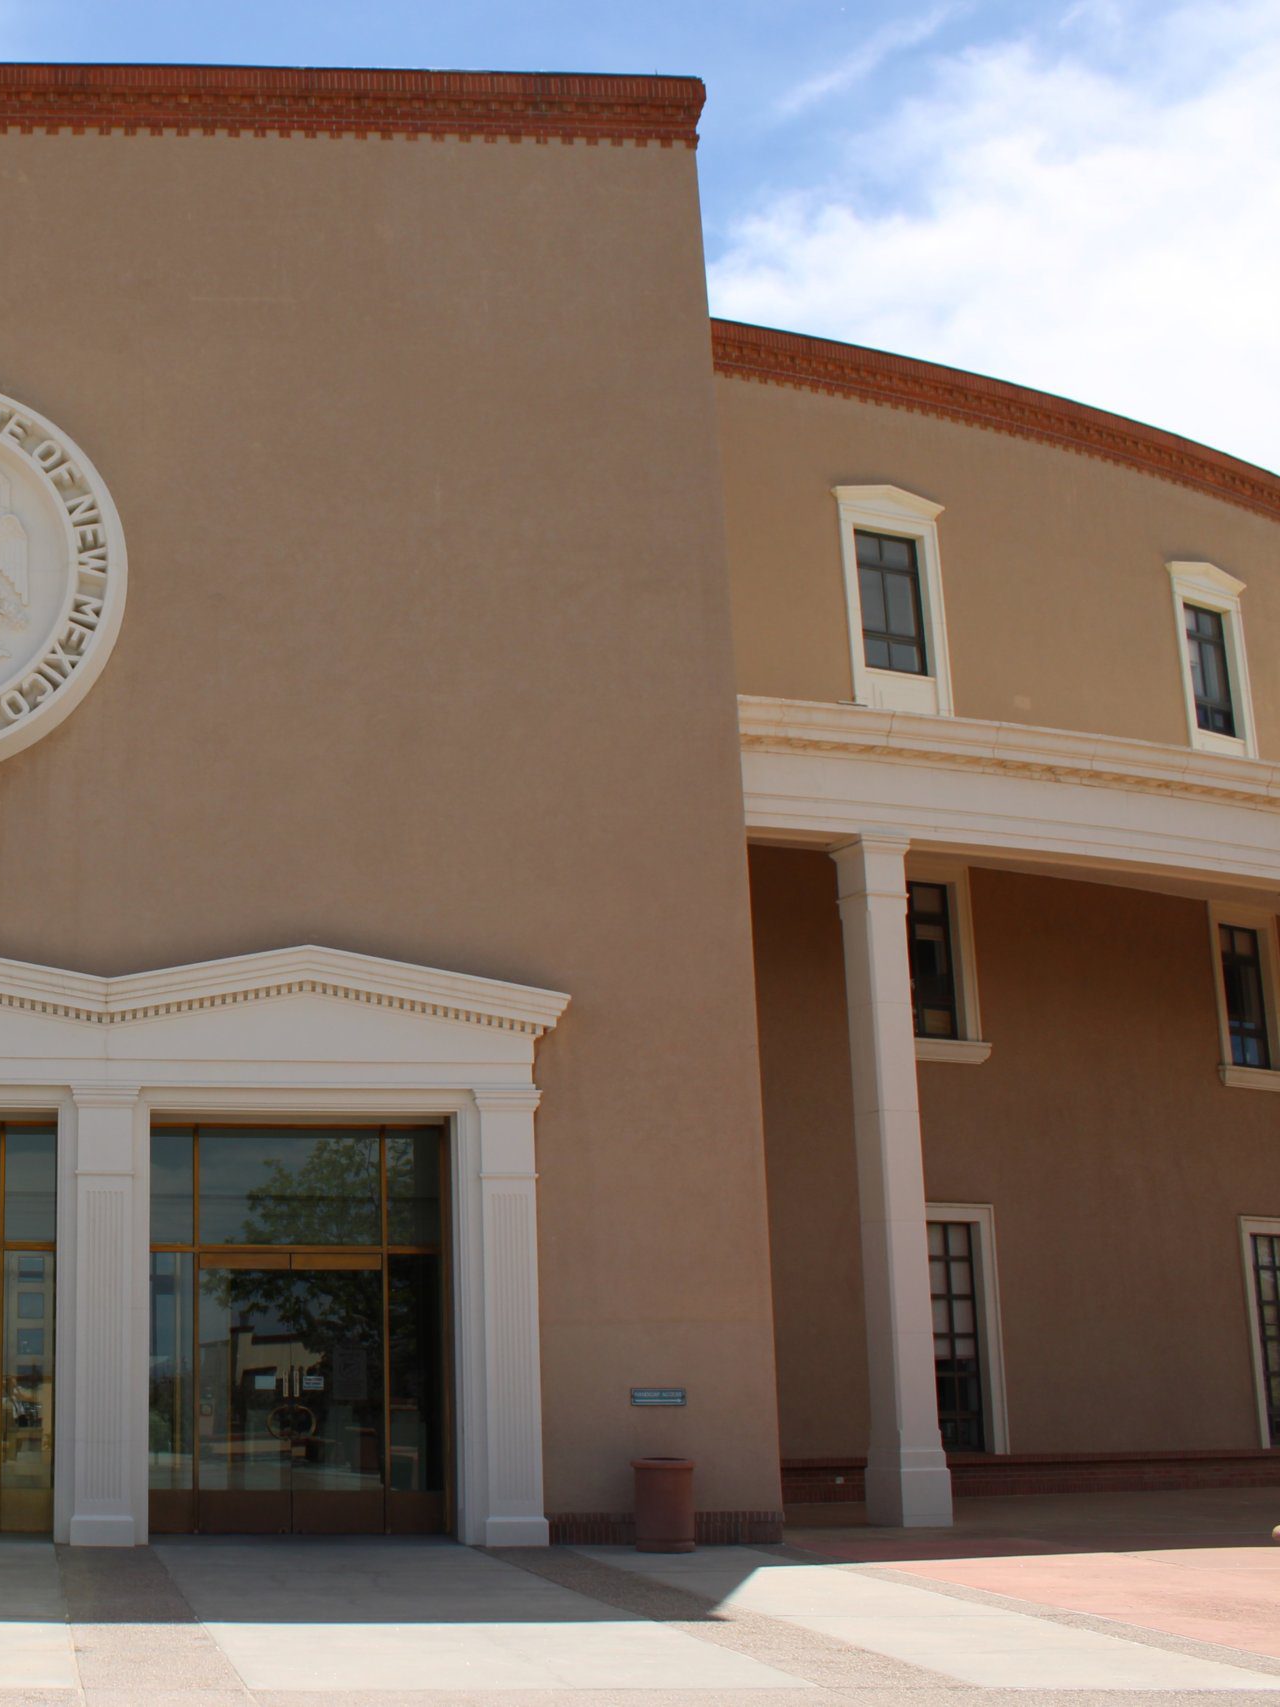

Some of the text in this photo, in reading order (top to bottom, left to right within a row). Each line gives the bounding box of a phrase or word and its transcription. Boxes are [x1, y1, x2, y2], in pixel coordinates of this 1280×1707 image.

[32, 439, 82, 485] OF
[65, 493, 107, 578] NEW
[0, 592, 105, 720] MEXICO
